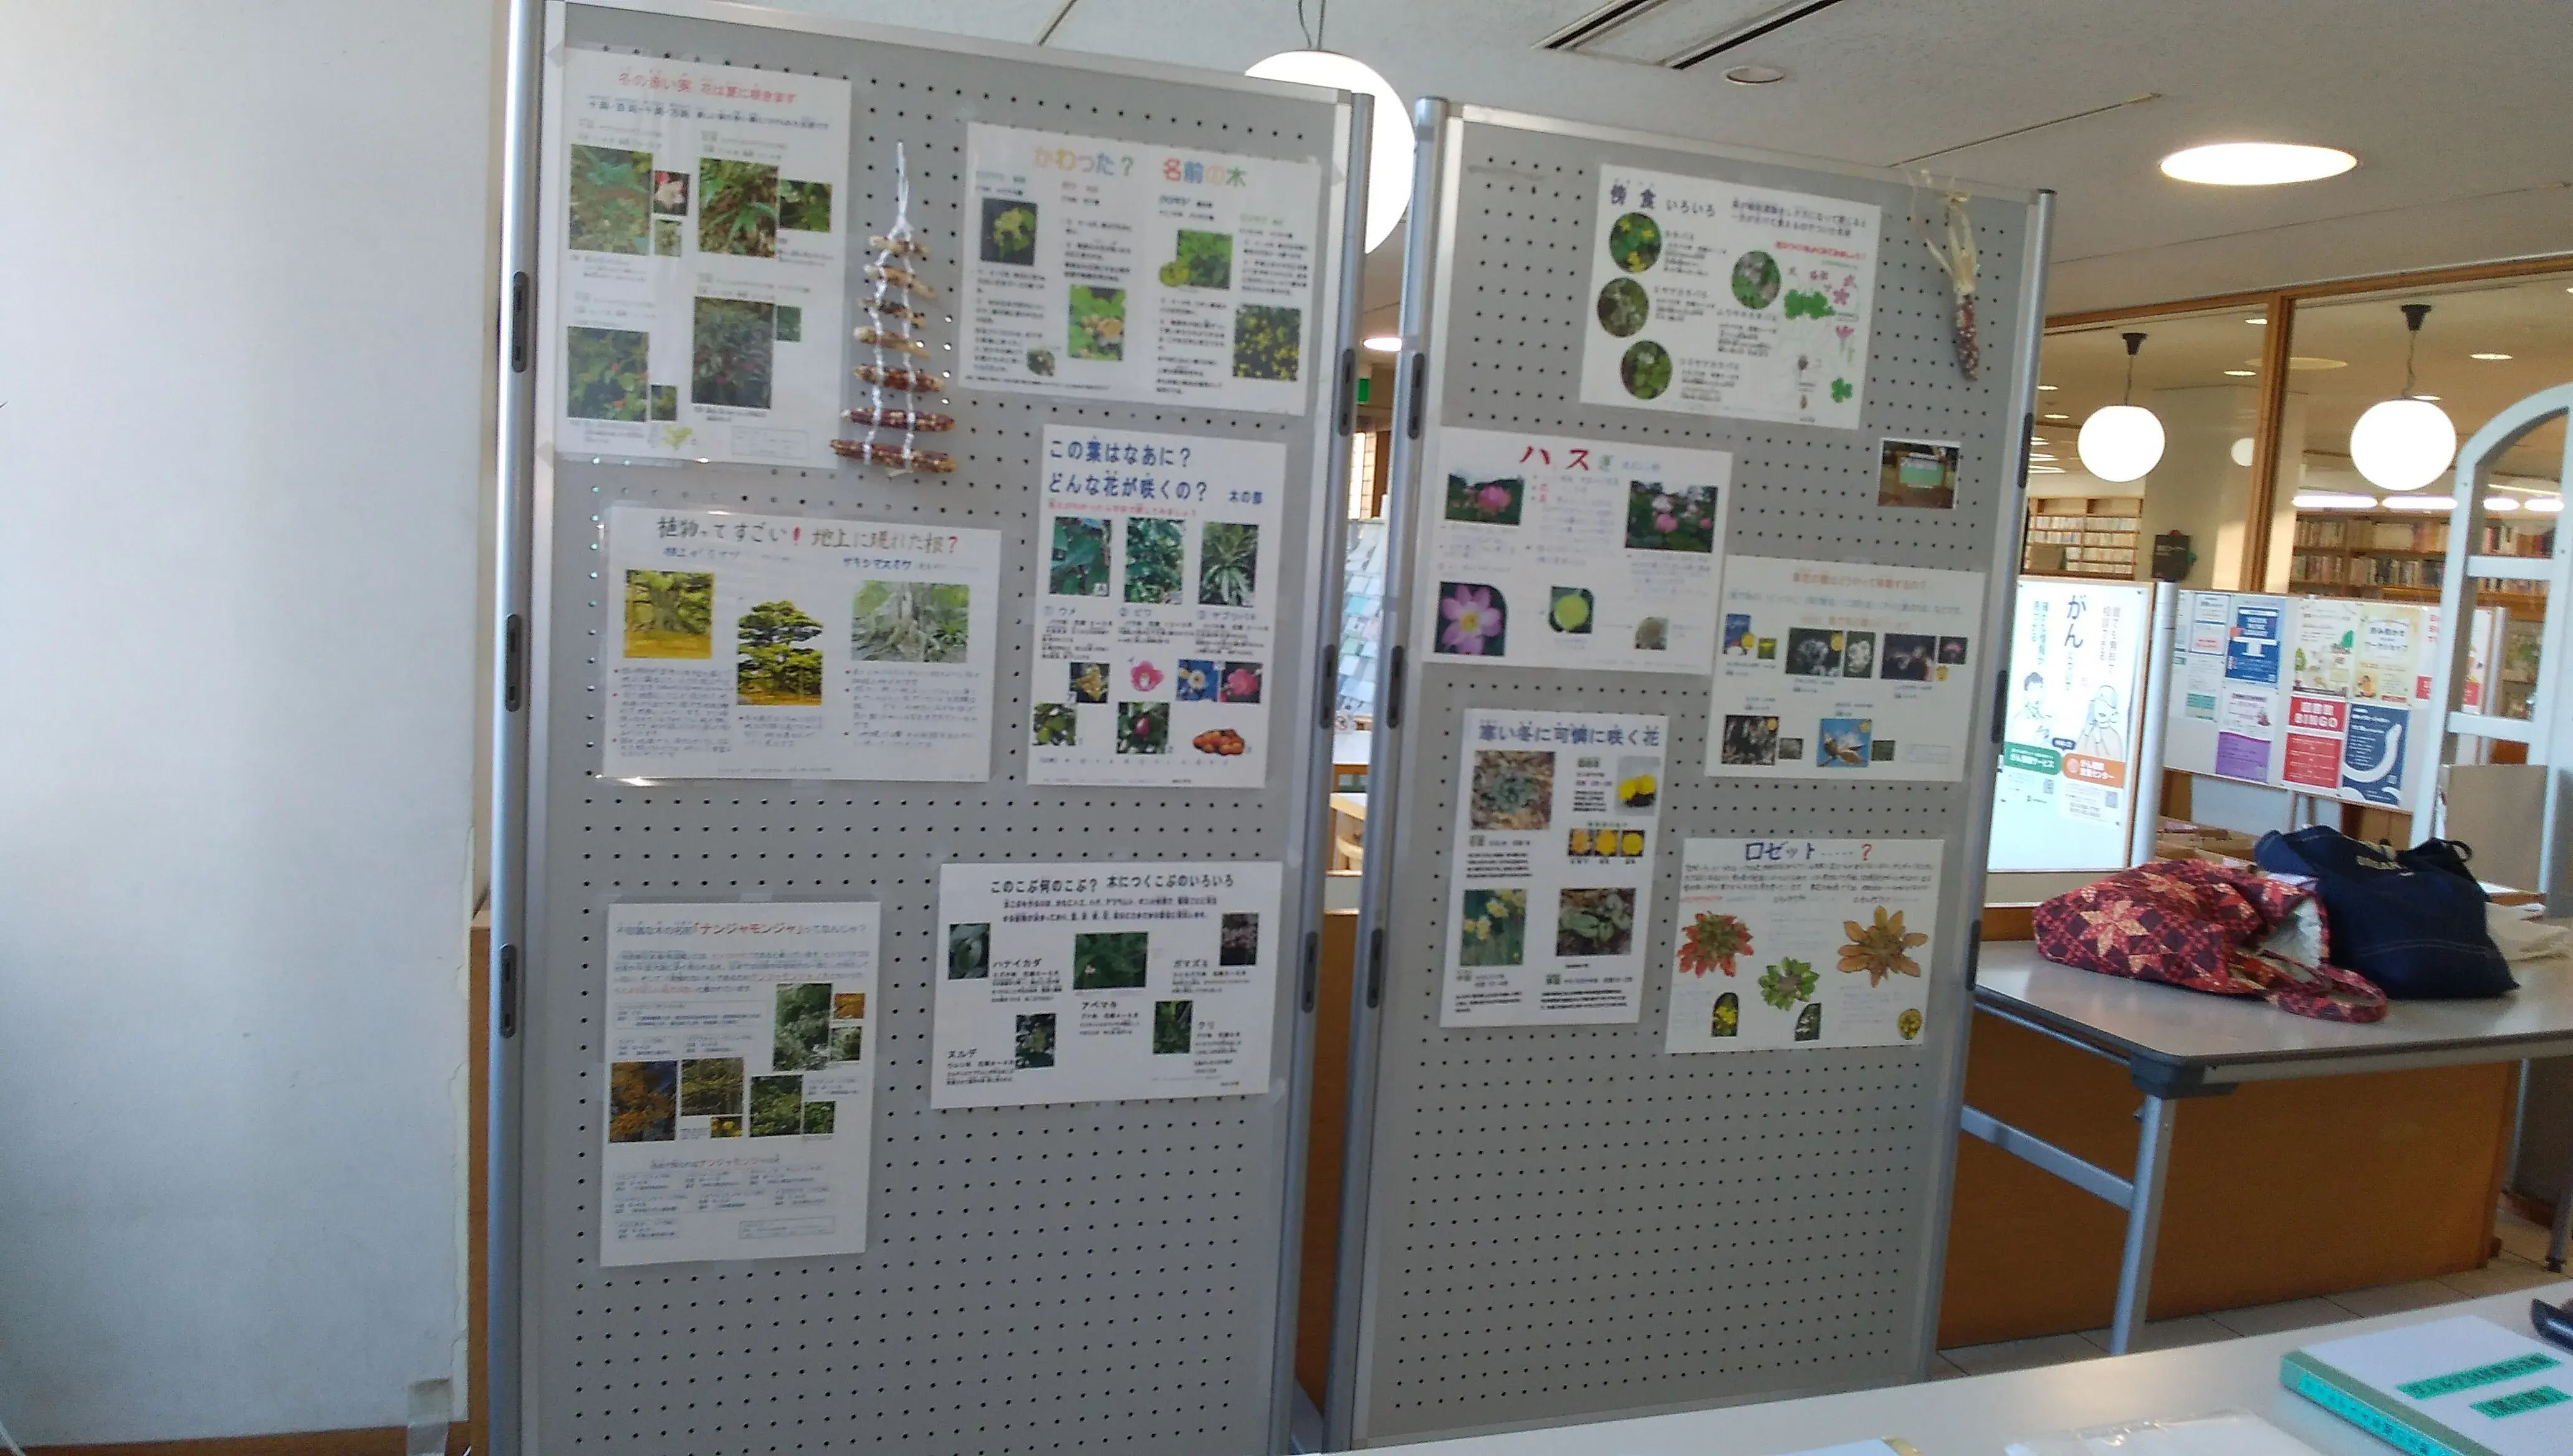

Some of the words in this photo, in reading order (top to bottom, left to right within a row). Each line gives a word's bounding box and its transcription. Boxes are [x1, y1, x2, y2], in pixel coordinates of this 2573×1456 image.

[1162, 156, 1247, 188] 名前の木
[1050, 439, 1192, 467] この葉はなあに？
[1048, 472, 1208, 502] どんな花が咲くの？
[2064, 595, 2088, 649] がん
[2295, 712, 2339, 728] BINGO
